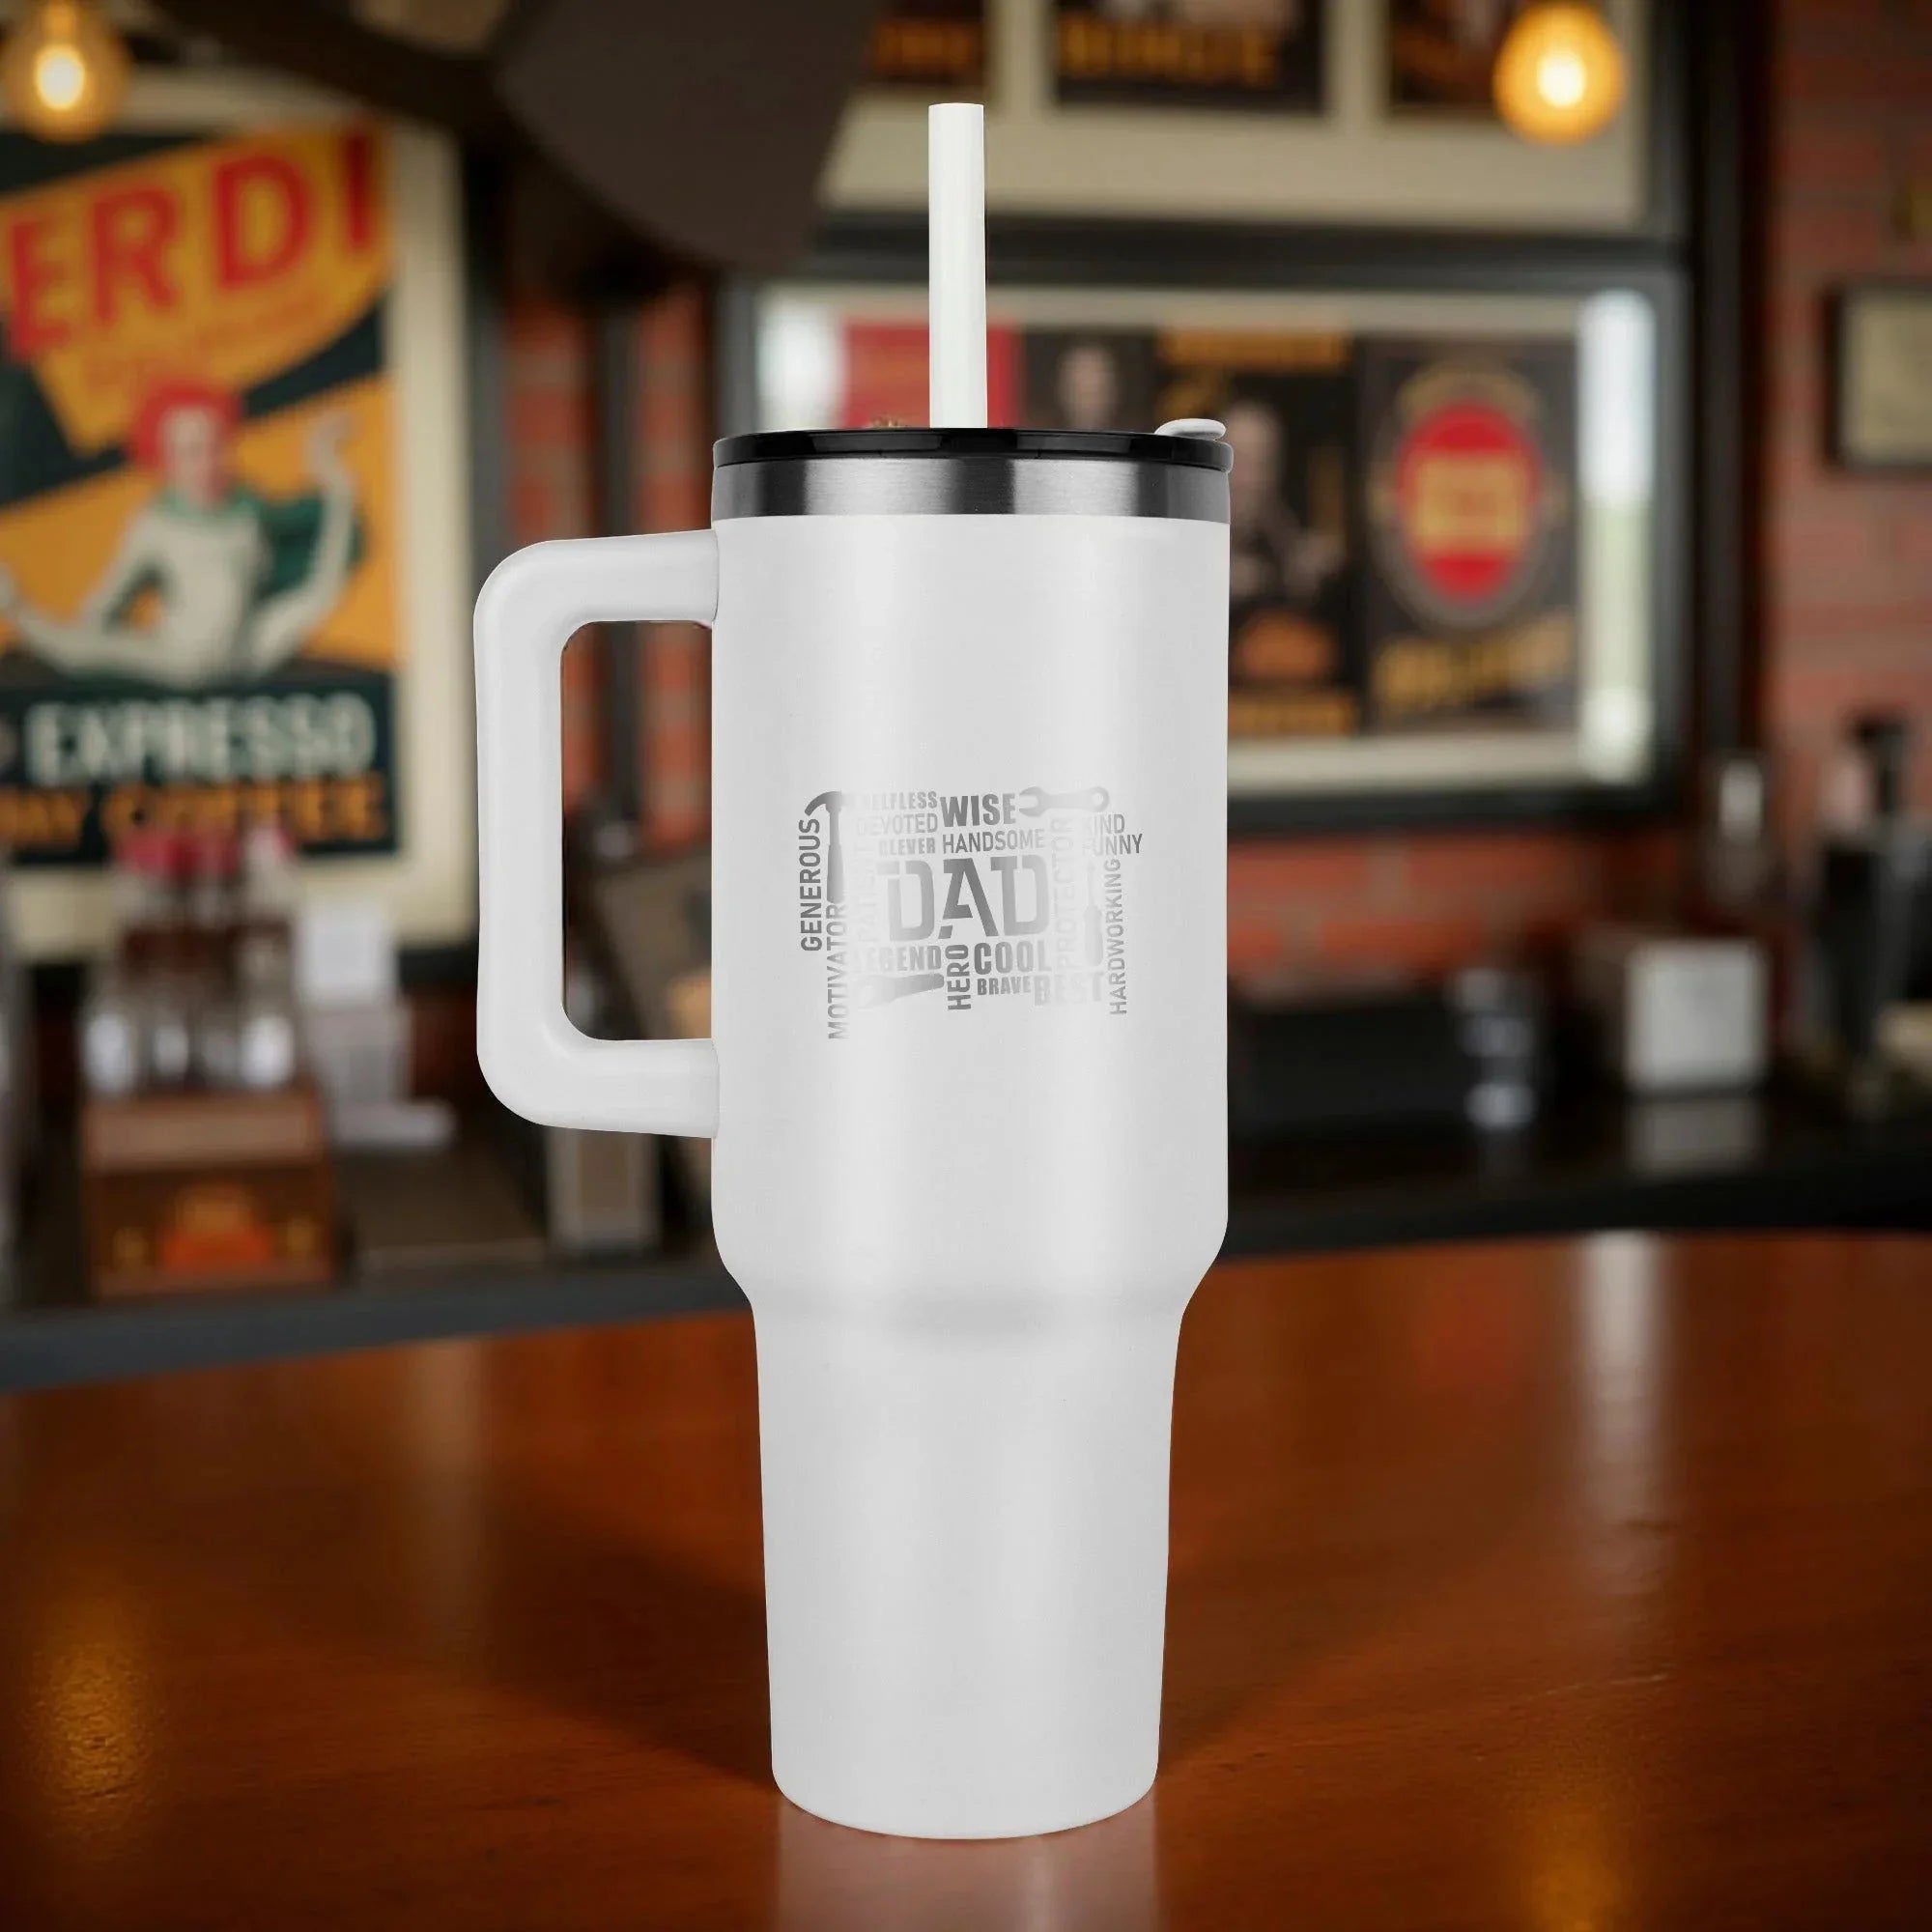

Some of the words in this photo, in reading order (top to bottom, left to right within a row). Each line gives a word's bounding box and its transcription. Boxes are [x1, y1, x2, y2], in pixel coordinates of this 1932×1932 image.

[861, 791, 937, 810] ELFLESS
[940, 793, 1016, 827] WISE
[857, 813, 938, 837] DEVOTED
[943, 829, 1045, 854] HANDSOME
[879, 838, 935, 856] CLEVER
[799, 819, 822, 951] GENEROUS
[876, 855, 1049, 942] DAD
[1051, 817, 1074, 970] PROTECTOR
[1104, 859, 1126, 1015] HARDWORKING
[826, 903, 849, 1039] MOTIVATOR
[852, 945, 942, 973] EGEND
[974, 941, 1051, 974] COOL
[946, 945, 971, 1010] HERO
[978, 976, 1031, 996] BRAVE
